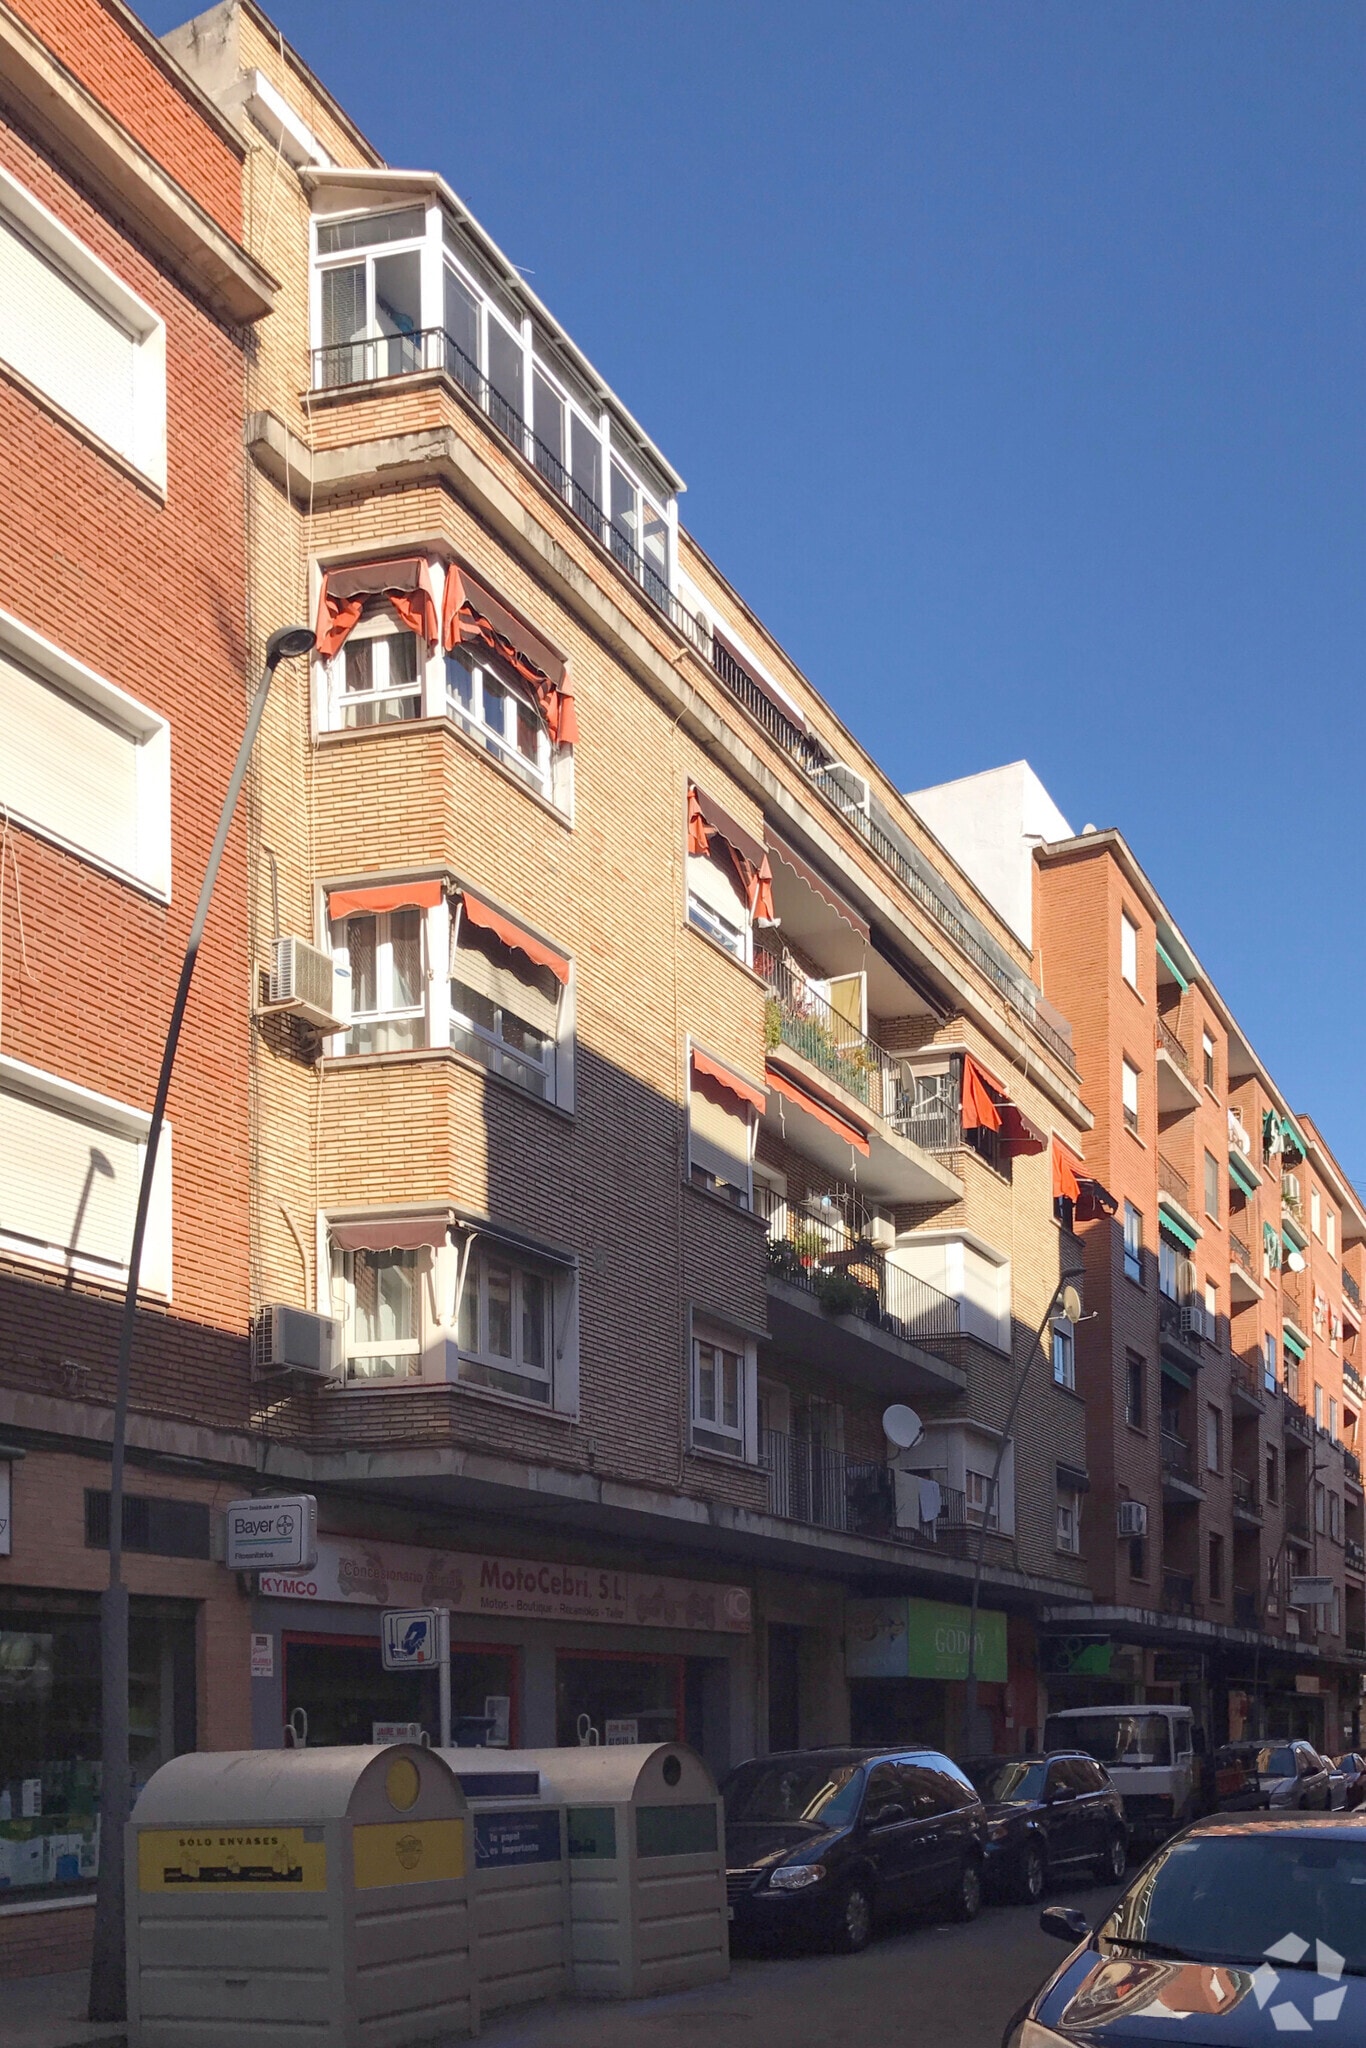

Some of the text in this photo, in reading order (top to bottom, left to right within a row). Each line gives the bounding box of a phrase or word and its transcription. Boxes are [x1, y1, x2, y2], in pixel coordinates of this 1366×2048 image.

[235, 1519, 274, 1536] Bayer
[345, 1562, 423, 1583] Concesionario
[262, 1577, 318, 1596] KYMCO
[480, 1597, 509, 1609] Motos
[517, 1600, 553, 1614] Boutique
[220, 1837, 279, 1846] ENVASES
